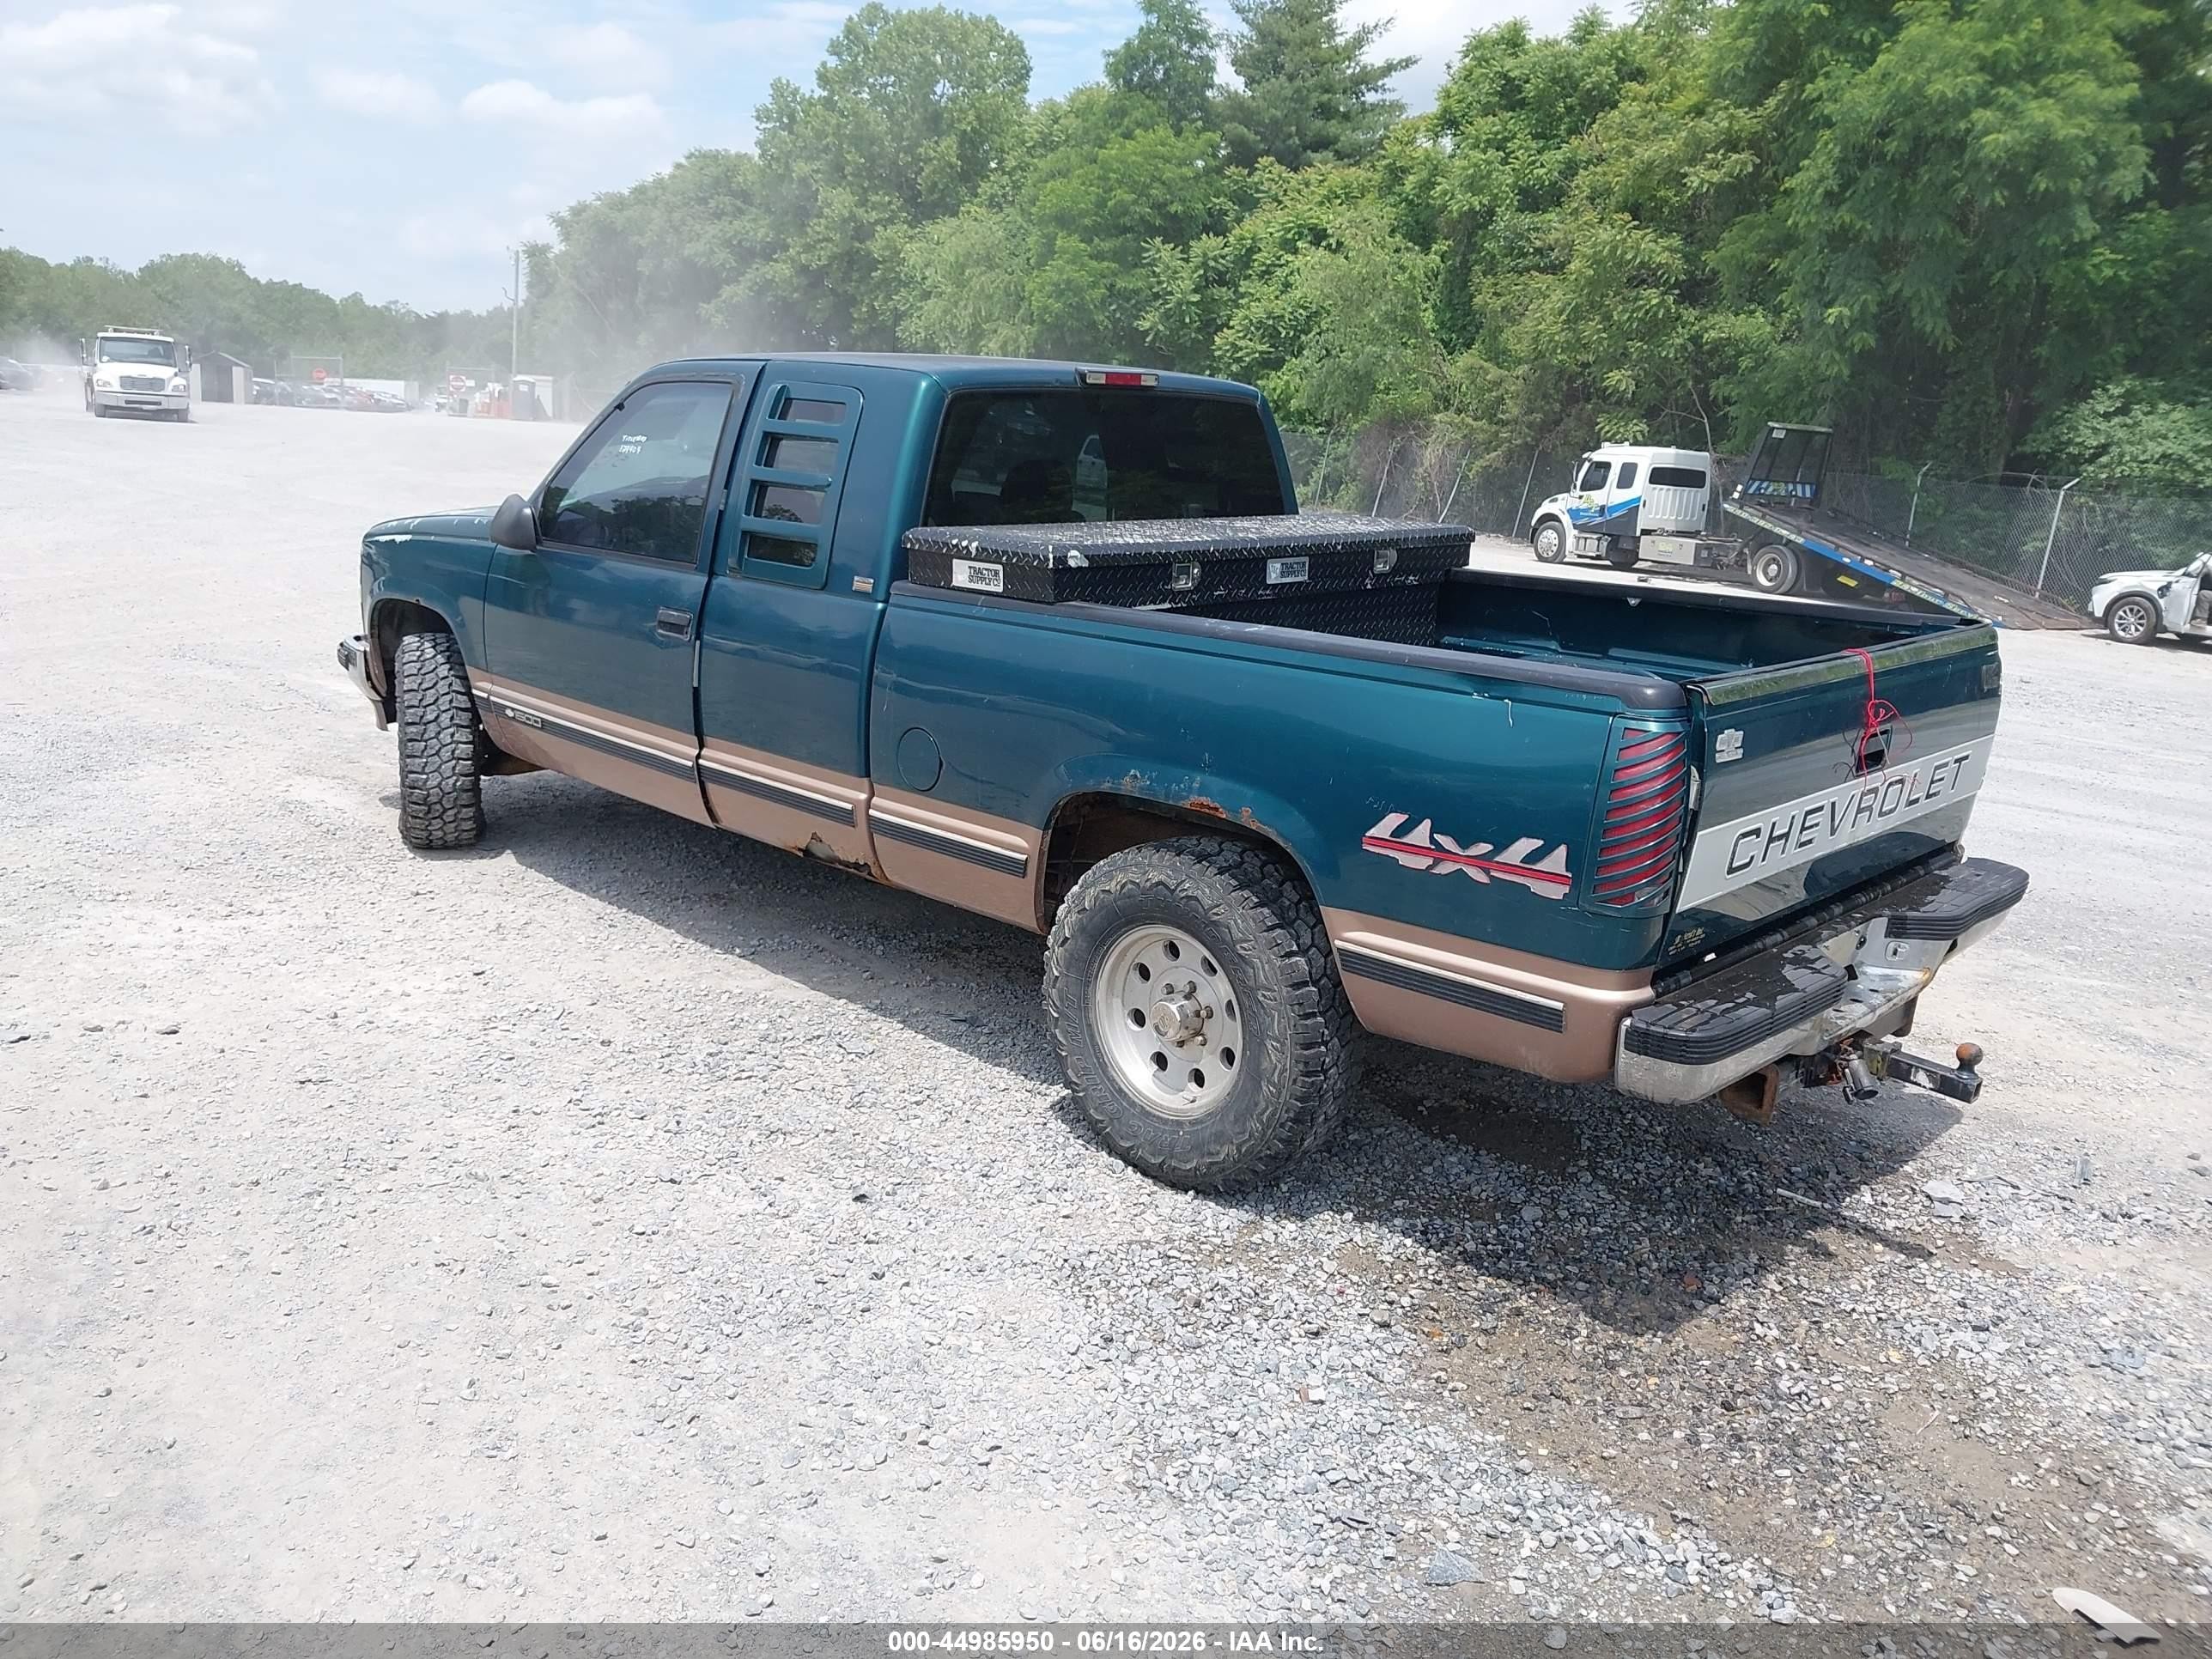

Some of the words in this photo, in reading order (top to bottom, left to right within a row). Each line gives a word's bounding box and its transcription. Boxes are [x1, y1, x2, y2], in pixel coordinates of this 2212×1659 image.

[968, 566, 1000, 578] TRACTOR
[968, 575, 992, 586] SUPPLY
[1725, 750, 1972, 879] CHEVROLET
